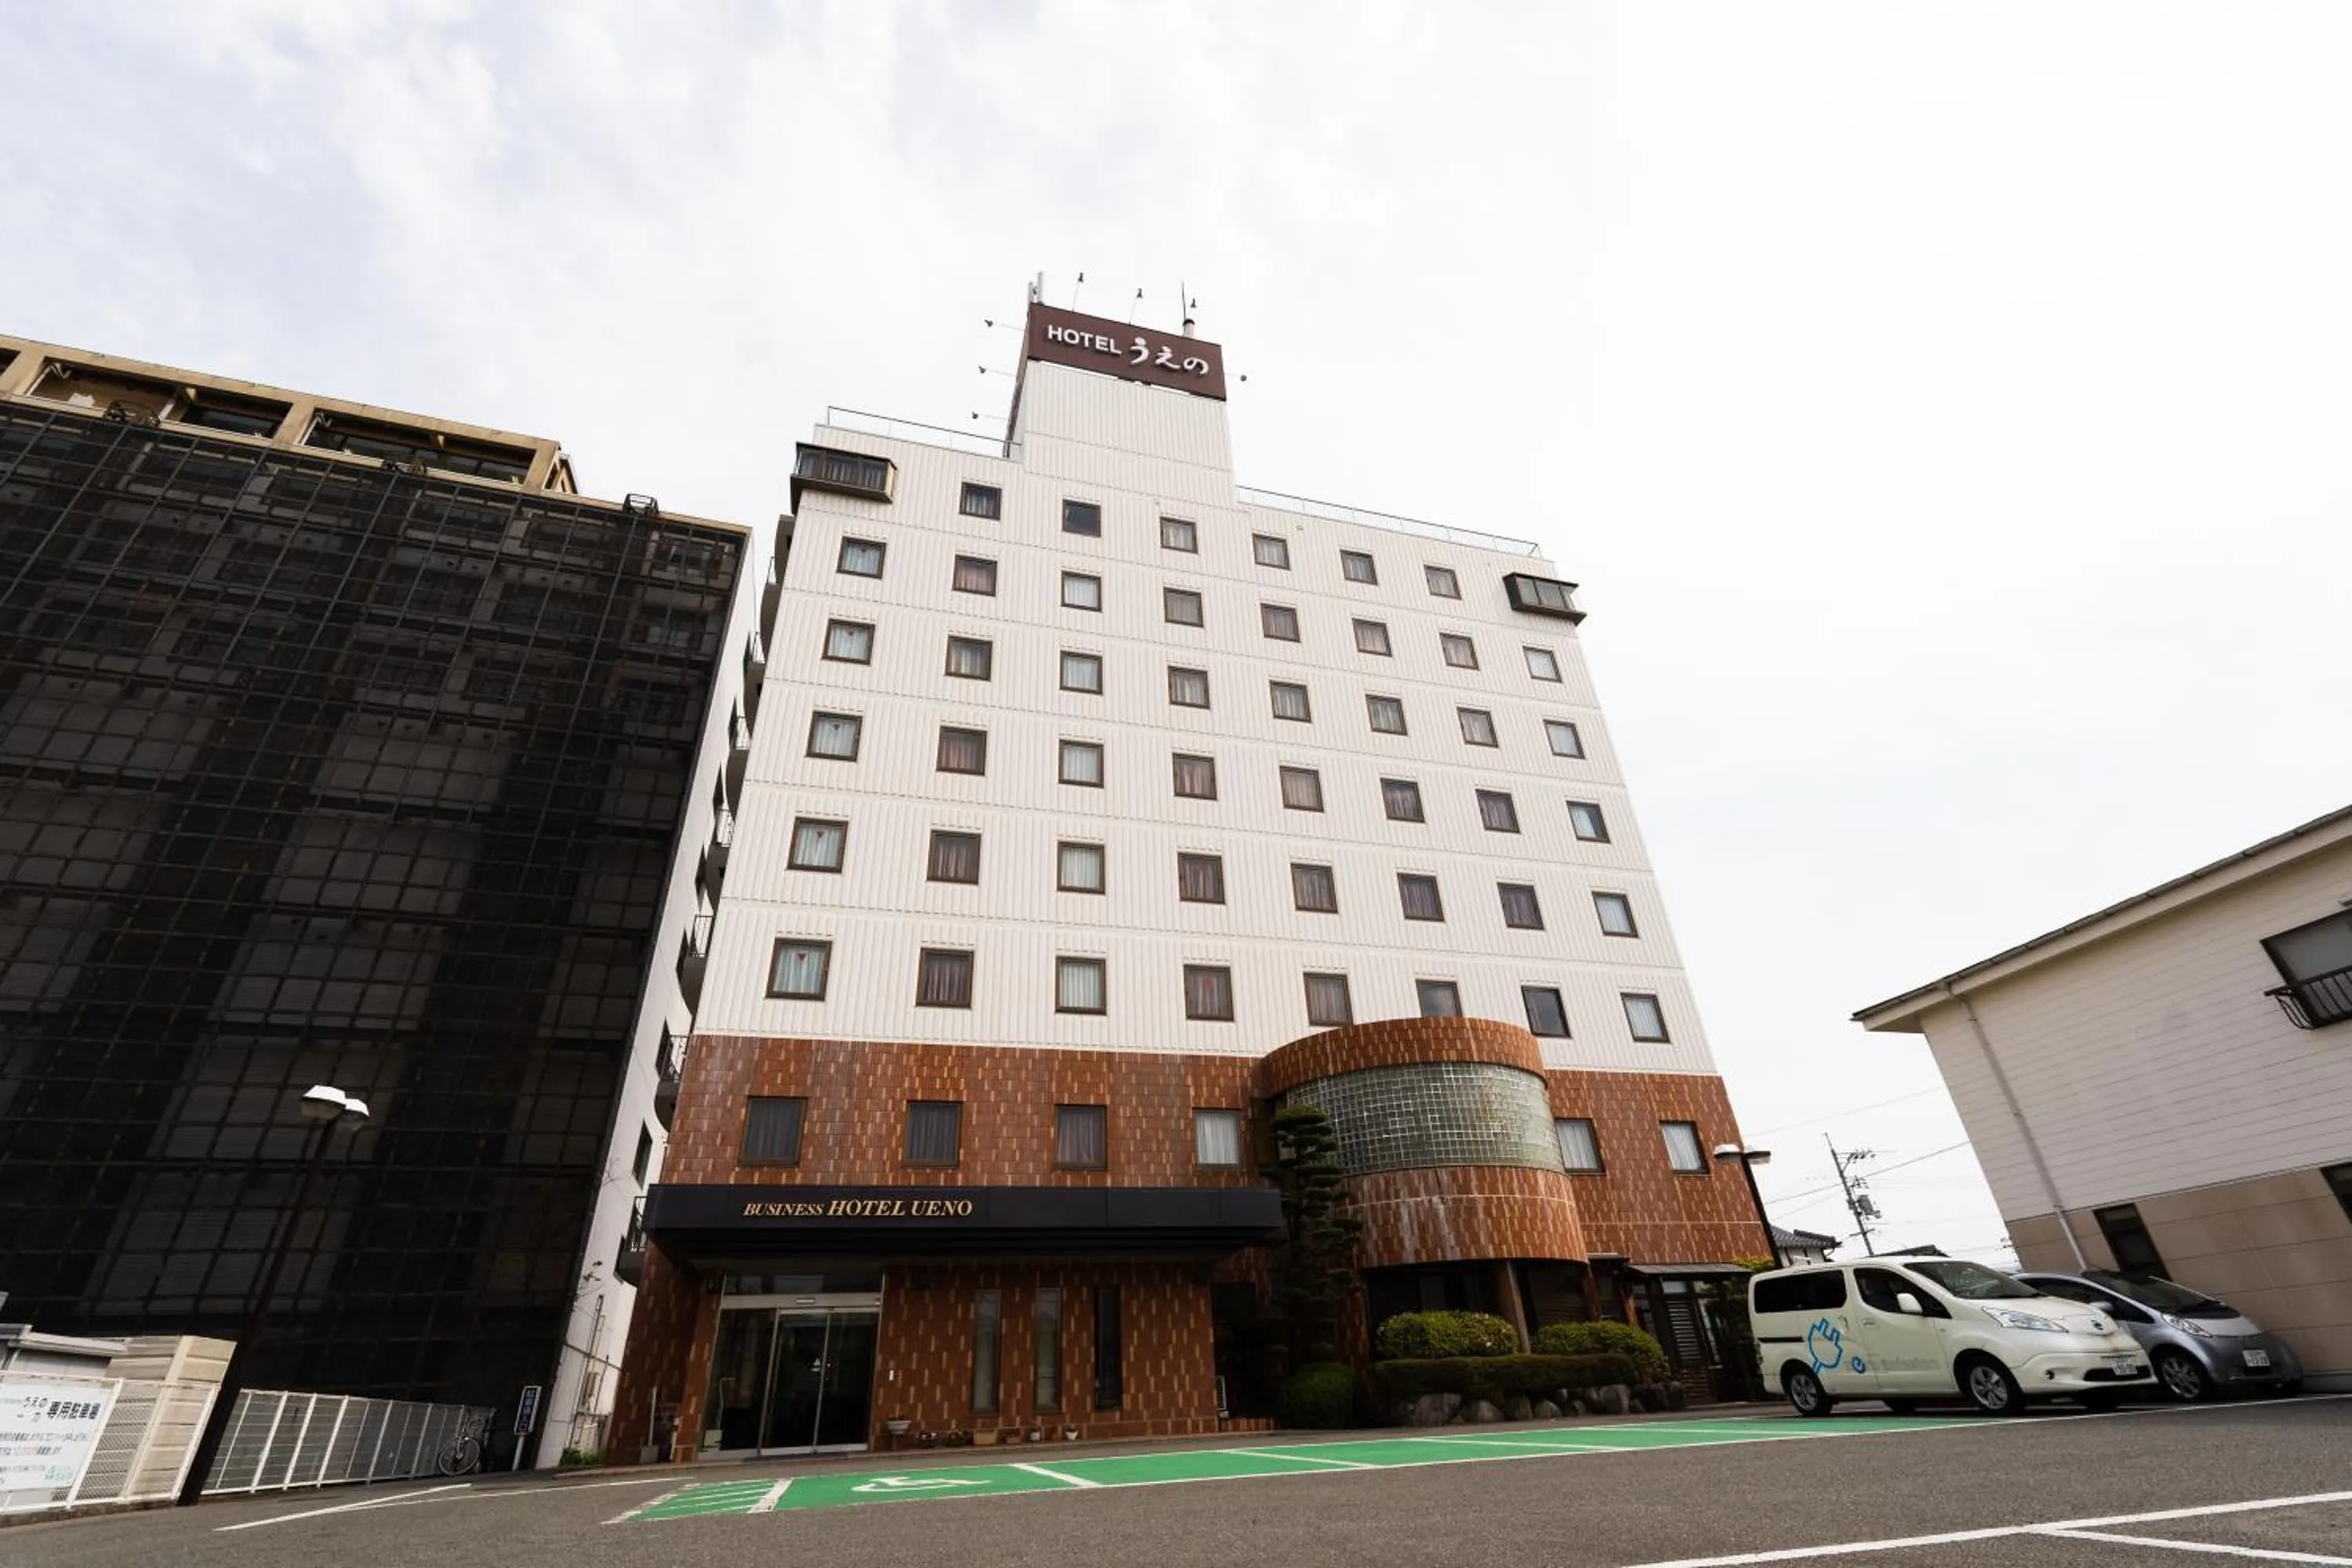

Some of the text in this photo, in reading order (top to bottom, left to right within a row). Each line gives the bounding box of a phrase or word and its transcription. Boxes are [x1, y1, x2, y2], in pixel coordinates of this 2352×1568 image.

[1047, 324, 1209, 375] HOTEL うえの
[745, 1200, 972, 1216] BUSINESS HOTEL UENO
